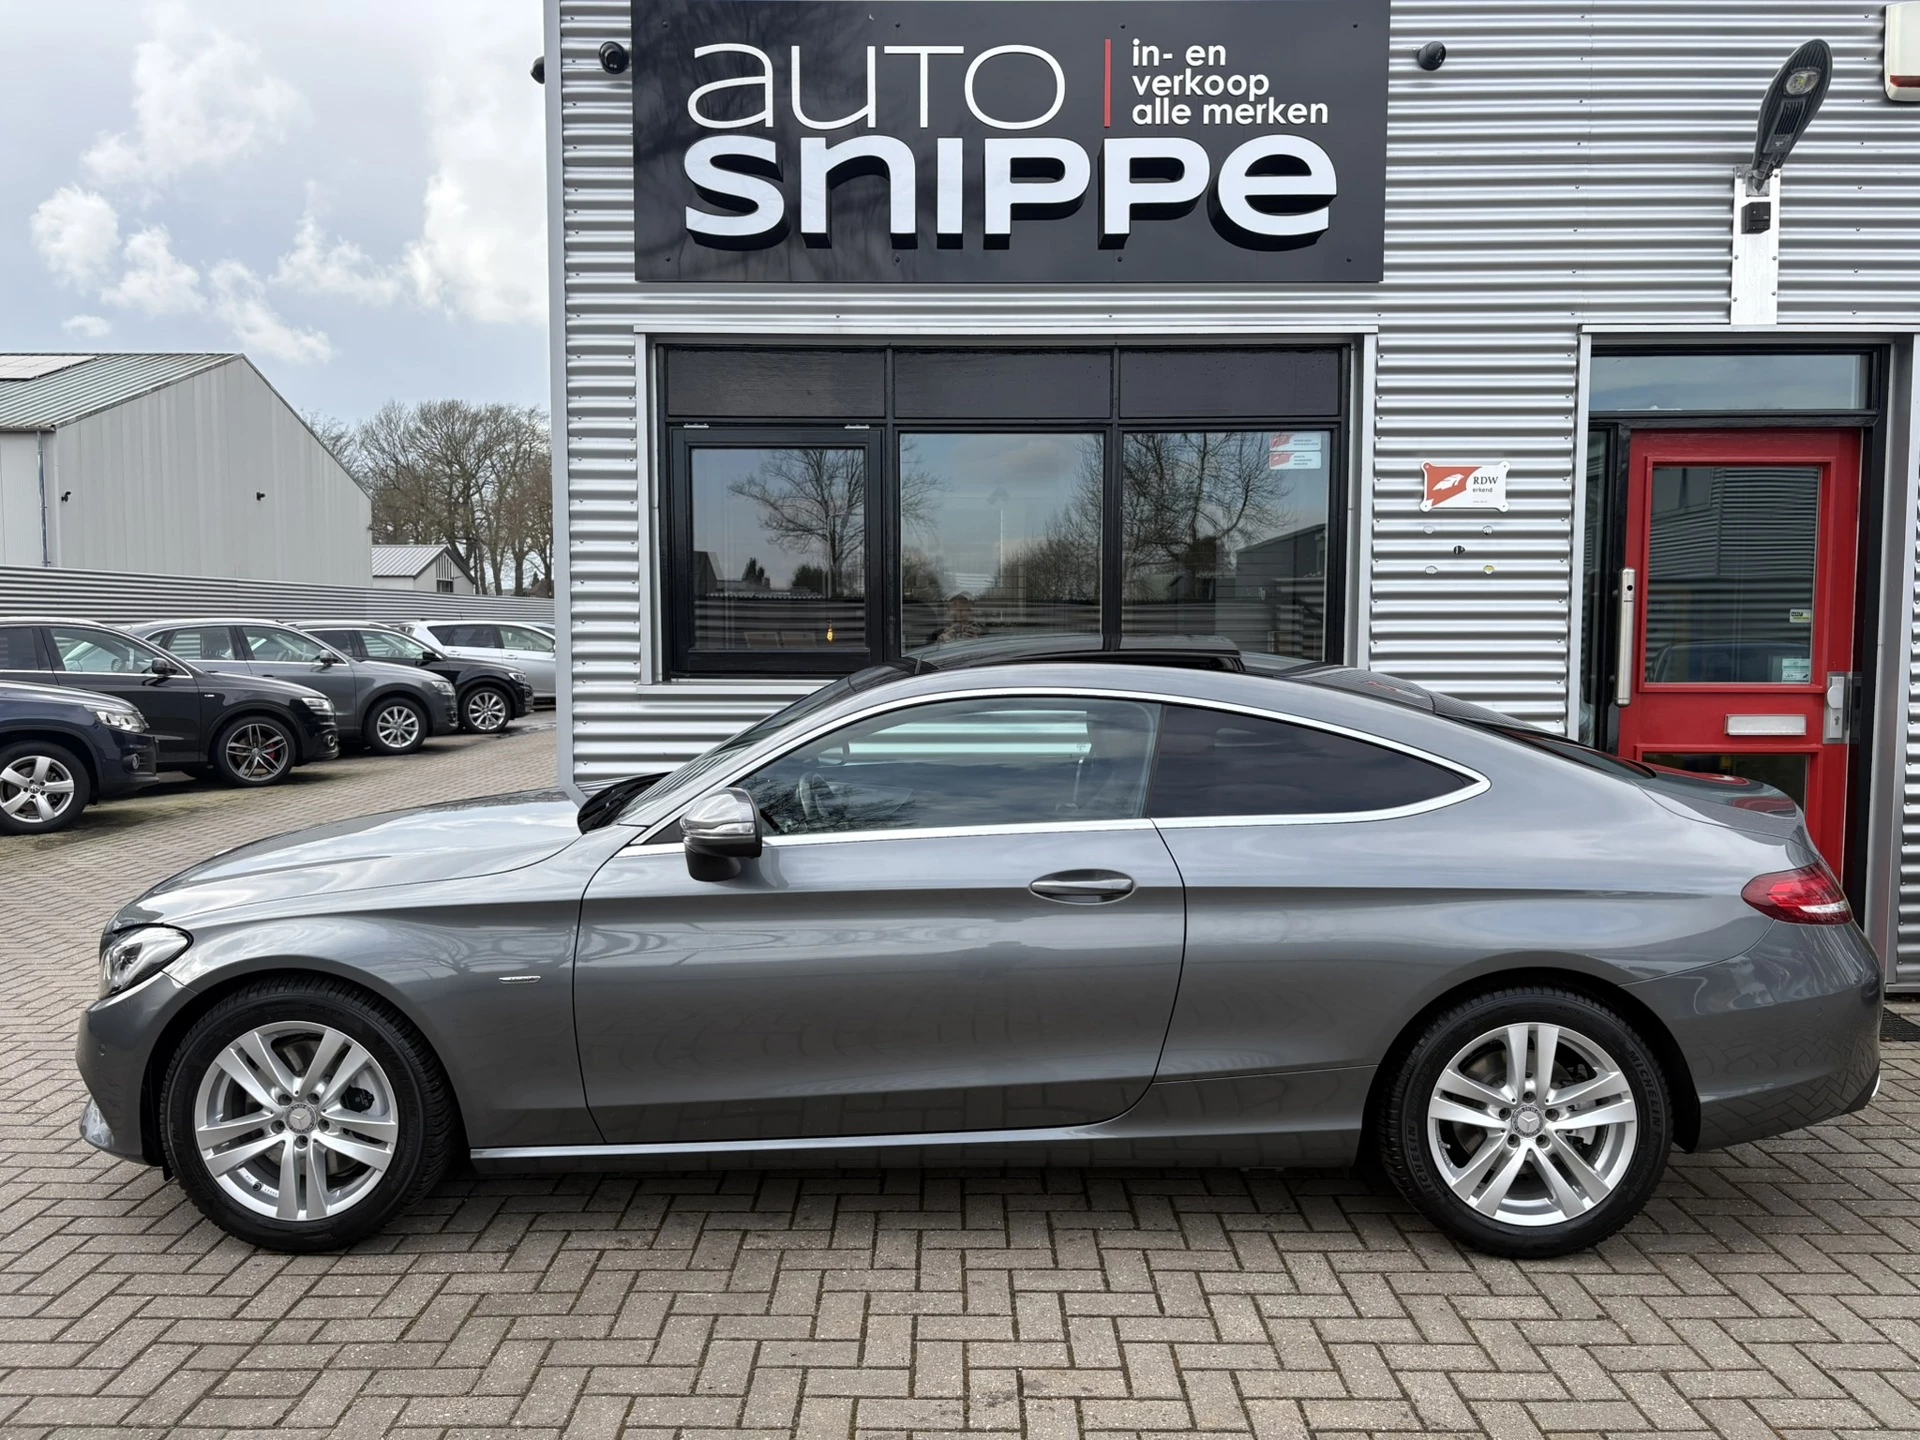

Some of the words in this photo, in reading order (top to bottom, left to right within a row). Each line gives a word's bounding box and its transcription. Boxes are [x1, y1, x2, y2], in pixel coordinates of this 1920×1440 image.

[1132, 38, 1174, 67] in-
[1185, 45, 1227, 67] en
[1131, 68, 1270, 102] verkoop
[1132, 96, 1192, 125] alle
[1203, 96, 1329, 125] merken
[1473, 476, 1499, 485] RDW
[1627, 1050, 1661, 1128] MICHELIN
